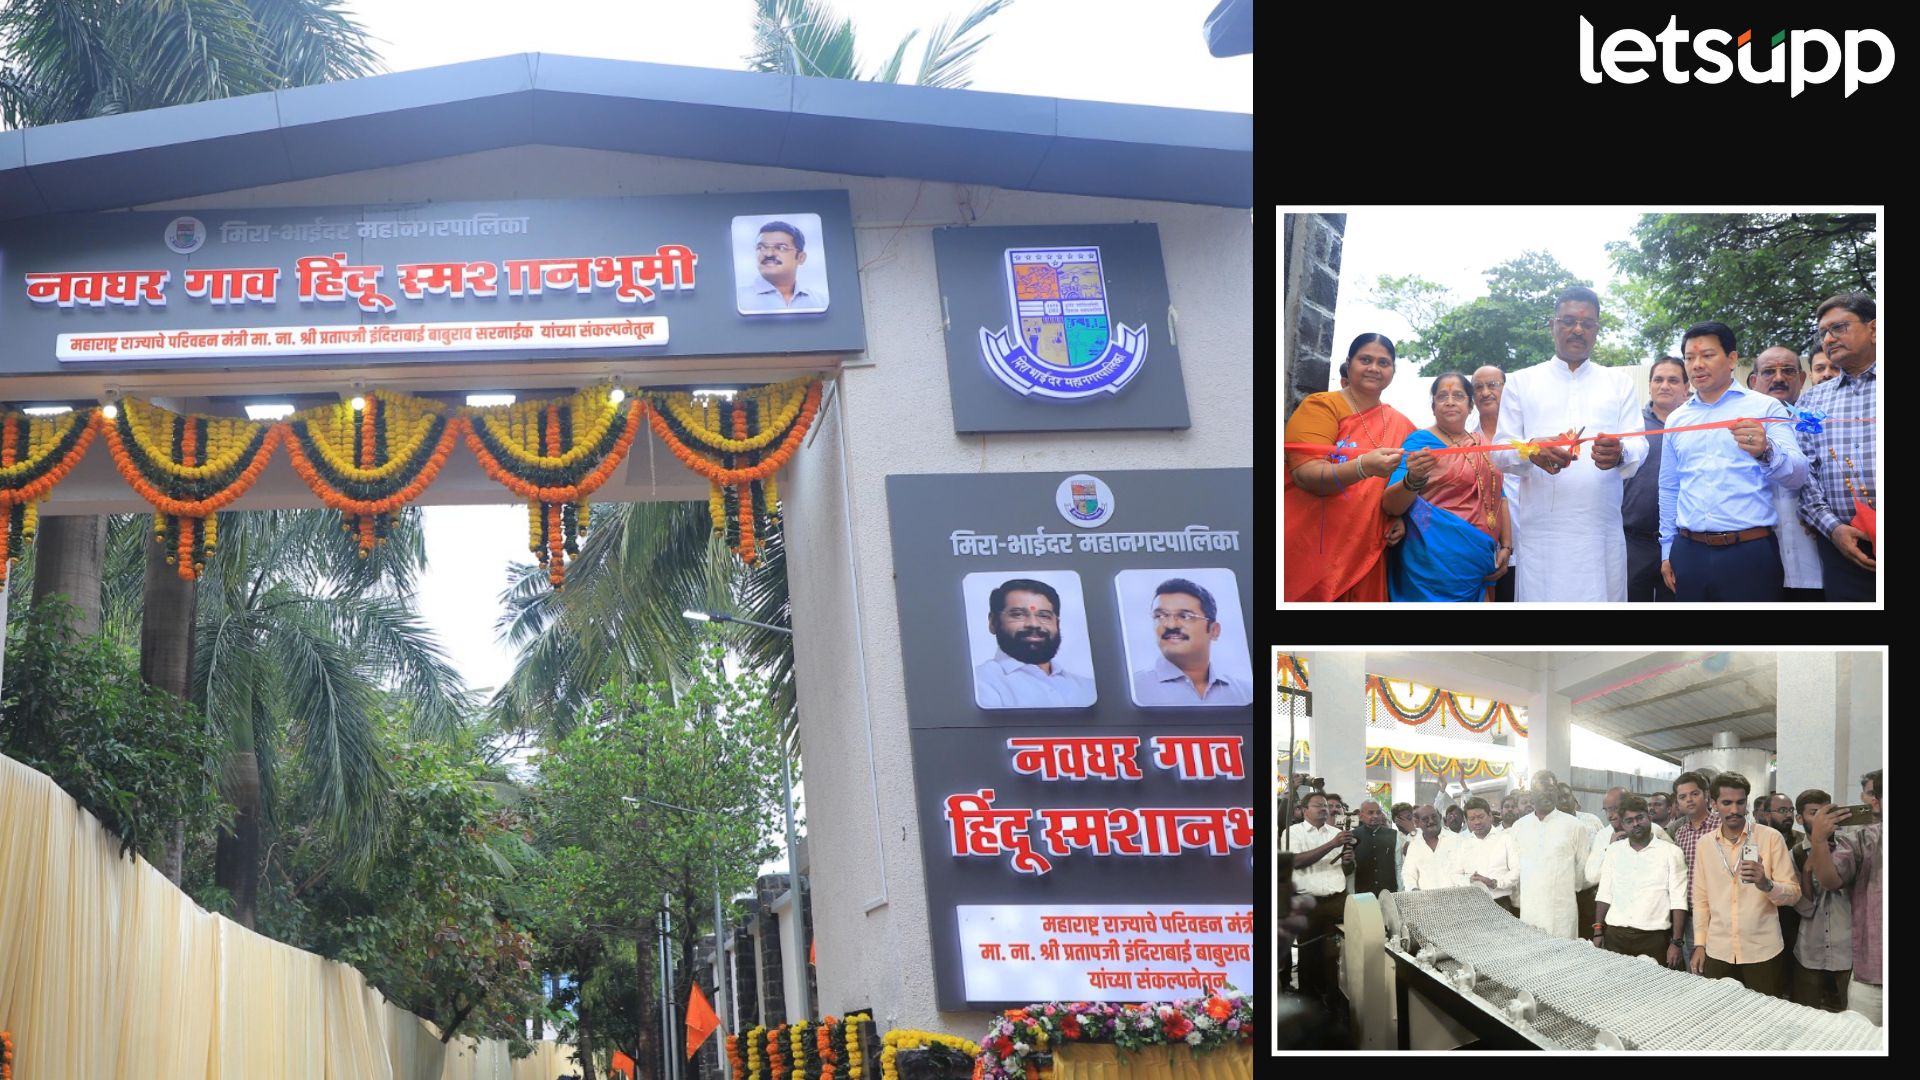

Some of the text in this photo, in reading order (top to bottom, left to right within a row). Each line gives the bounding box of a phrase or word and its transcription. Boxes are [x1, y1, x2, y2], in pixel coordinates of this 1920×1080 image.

[355, 213, 530, 240] महानगरपालिका
[25, 270, 171, 308] नवघर
[184, 267, 282, 305] गाव
[295, 251, 397, 314] हिंदू
[70, 319, 655, 353] महाराष्ट्र राज्याचे परिवहन मंत्री मा. ना. श्री प्रतापजी इंदिराबाई बाबुराव सरनाईक यांच्या संकल्पनेतून
[949, 525, 1240, 557] मिरा-भाईदर महानगरपालिका
[1007, 735, 1246, 781] नवघर गाव
[944, 788, 1253, 875] हिंदू स्मशानभ
[1041, 915, 1100, 937] महाराष्ट्र
[1102, 912, 1158, 934] राज्याचे
[1159, 911, 1223, 934] परिवहन
[979, 938, 1251, 968] मा. ना. श्री प्रतापजी इंदिराबाई बाबुराव
[1087, 966, 1228, 994] यांच्या संकल्पनेतून
